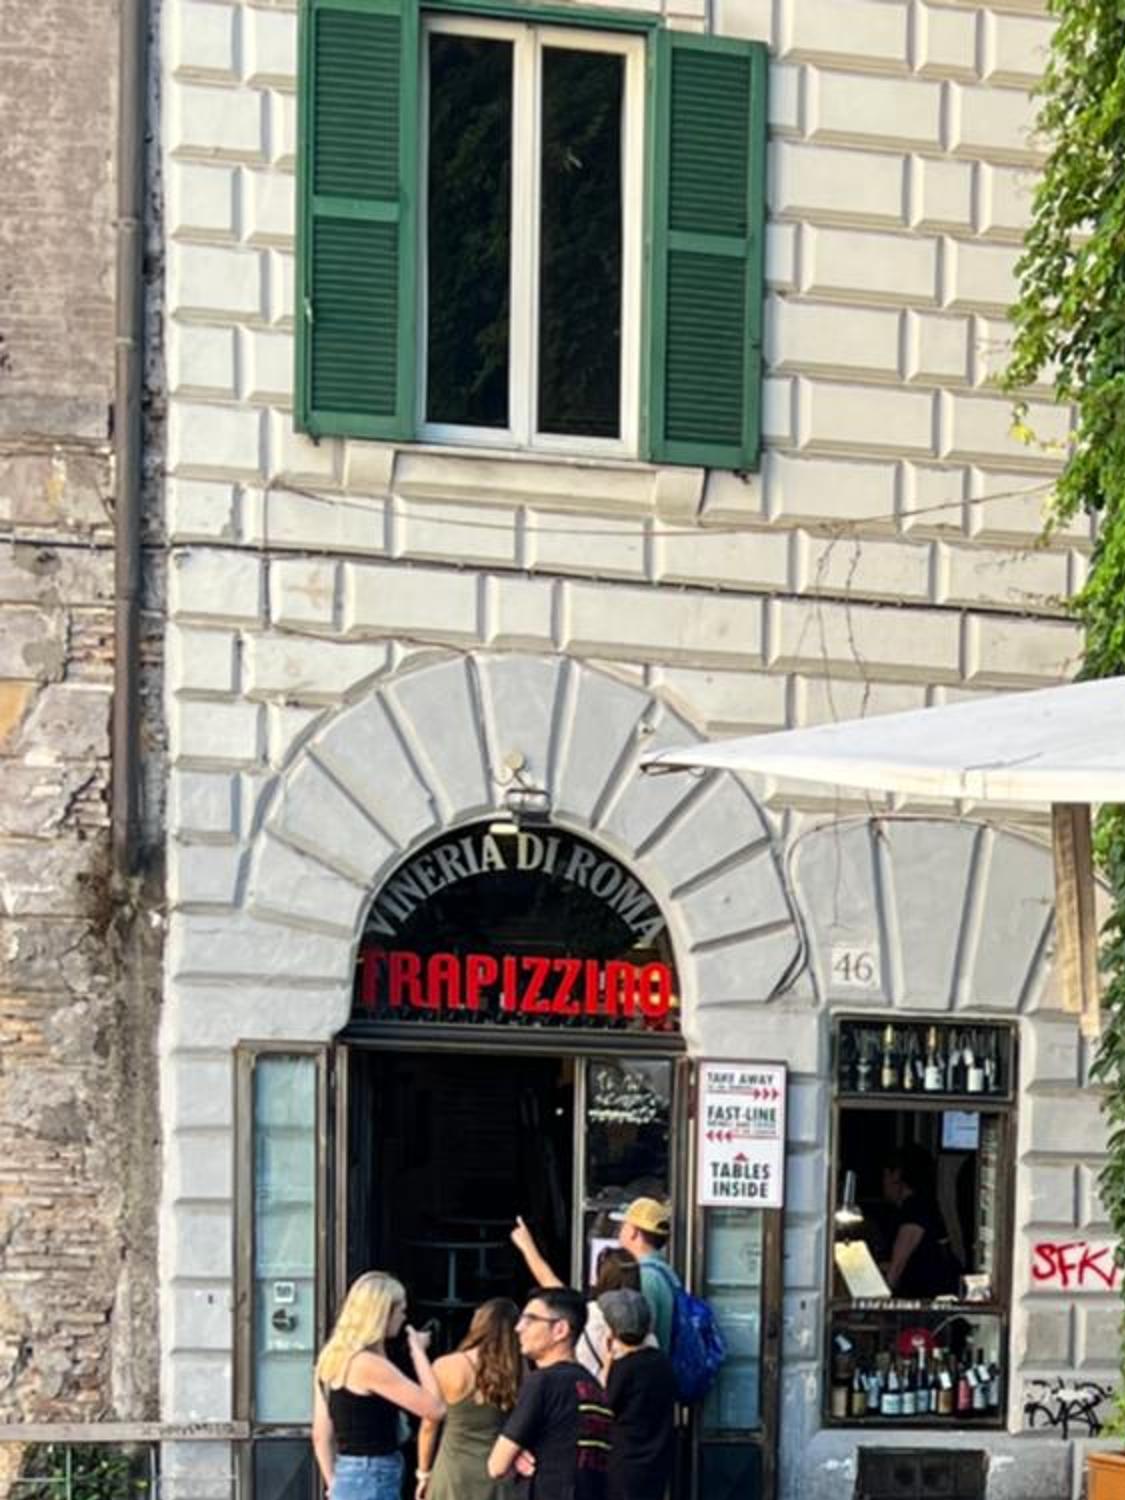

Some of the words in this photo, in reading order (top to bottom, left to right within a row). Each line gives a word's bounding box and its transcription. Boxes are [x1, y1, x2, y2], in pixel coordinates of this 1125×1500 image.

[366, 833, 506, 937] VINERIA
[516, 832, 560, 874] DI
[566, 844, 668, 948] ROMA
[833, 952, 873, 982] 46
[361, 949, 672, 1018] TRAPIZZINO
[707, 1071, 735, 1084] TAKE
[739, 1073, 774, 1085] AWAY
[710, 1161, 771, 1180] TABLES
[712, 1181, 769, 1198] INSIDE
